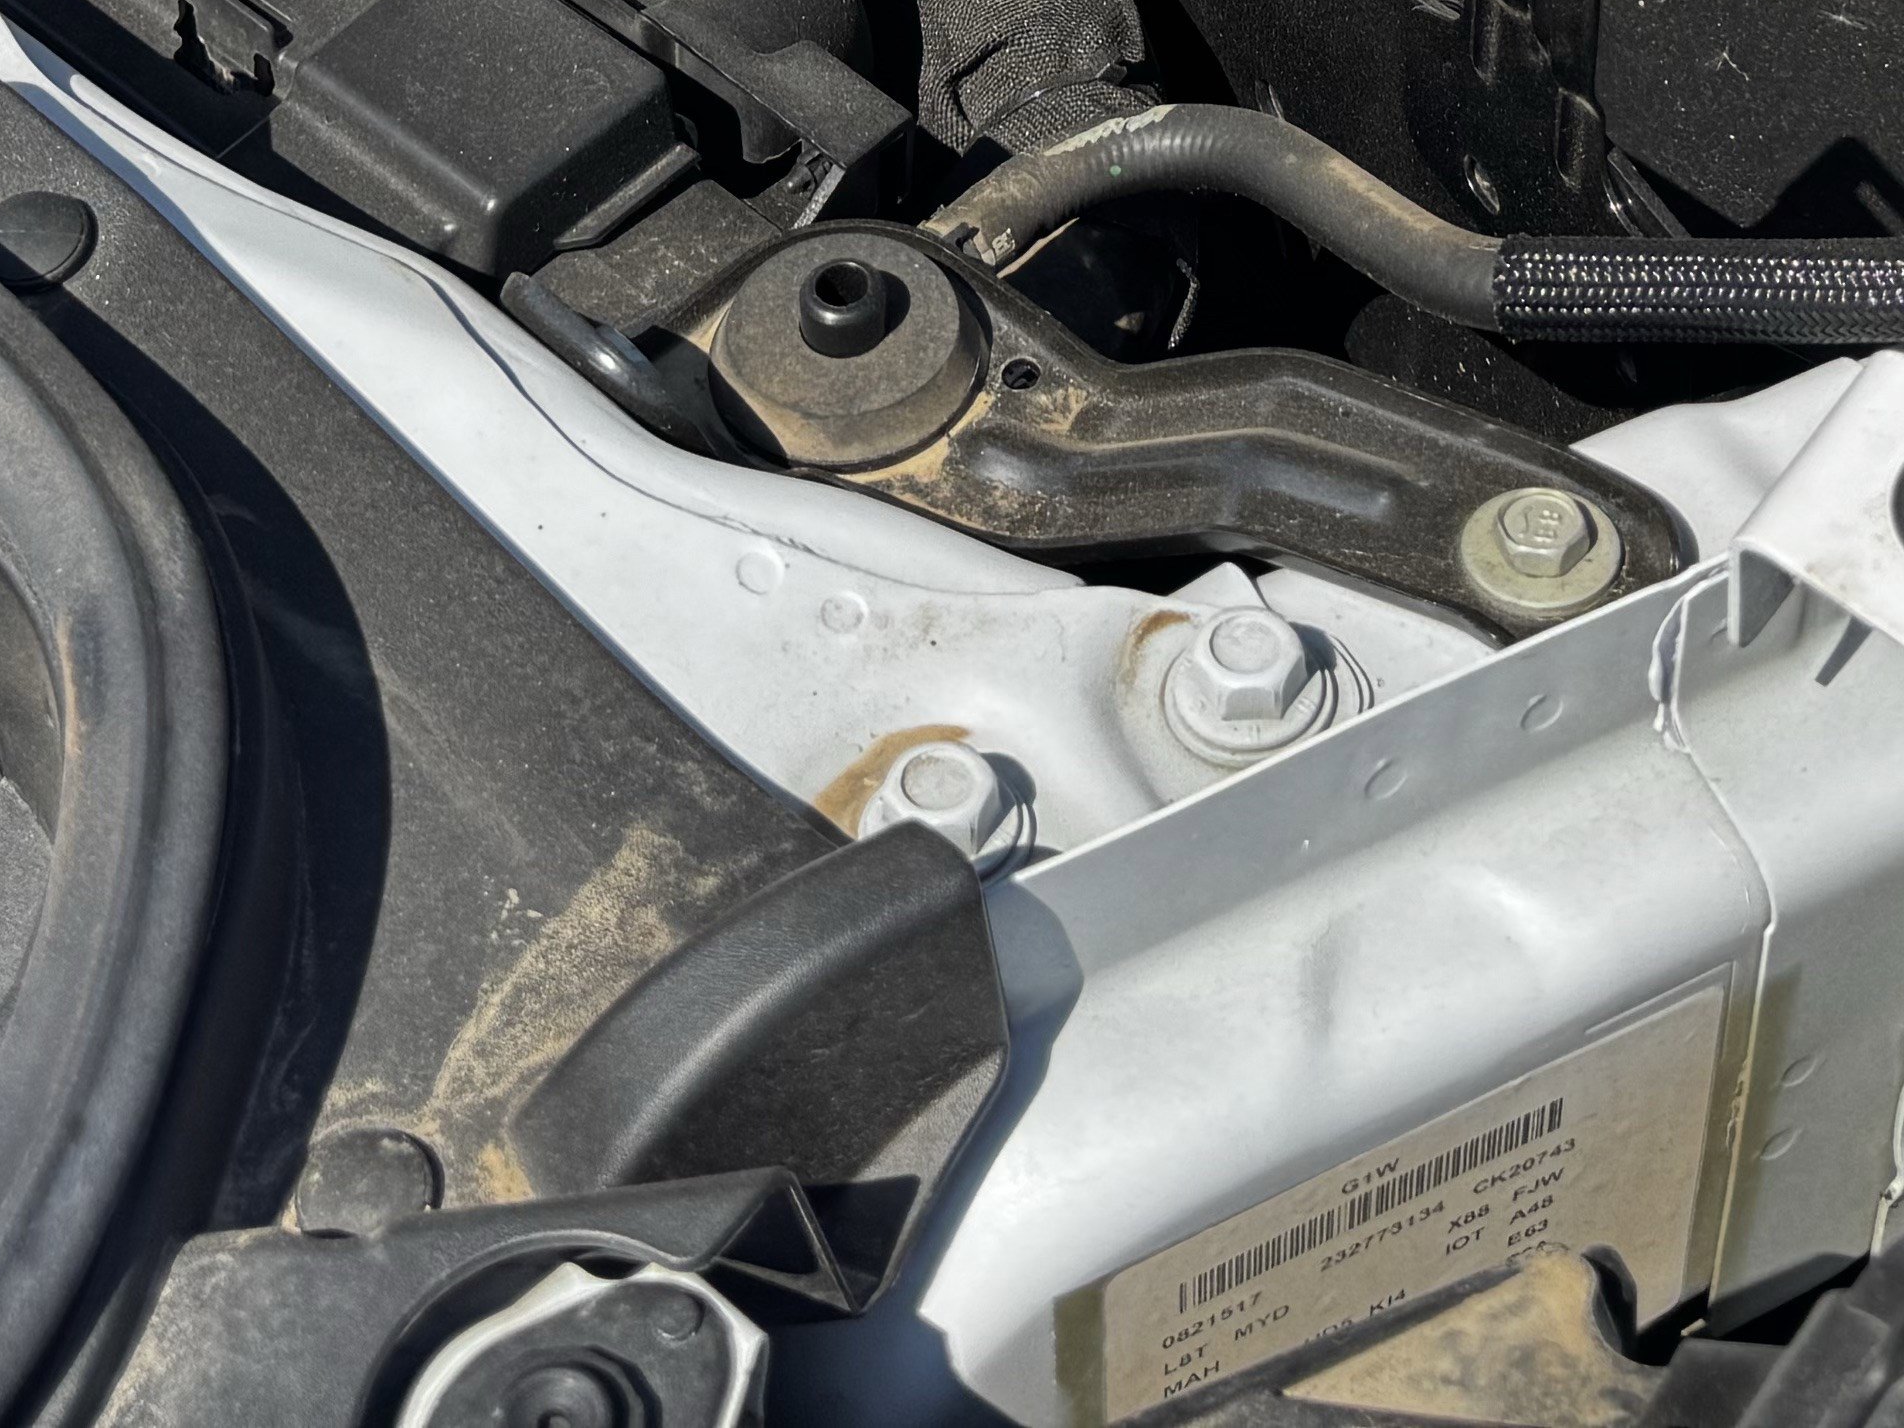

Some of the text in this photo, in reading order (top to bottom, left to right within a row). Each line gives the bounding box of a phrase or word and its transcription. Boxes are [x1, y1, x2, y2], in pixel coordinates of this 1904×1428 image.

[1162, 1291, 1263, 1350] 0821517
[1320, 1201, 1446, 1272] 232773134
[1473, 1138, 1576, 1195] CK20743
[1234, 1304, 1290, 1341] MYD
[1448, 1203, 1490, 1233] X88
[1512, 1168, 1565, 1201] FJW
[1342, 1158, 1399, 1195] G1W
[1507, 1219, 1549, 1247] E63
[1164, 1360, 1220, 1398] MAH
[1509, 1195, 1554, 1225] A48
